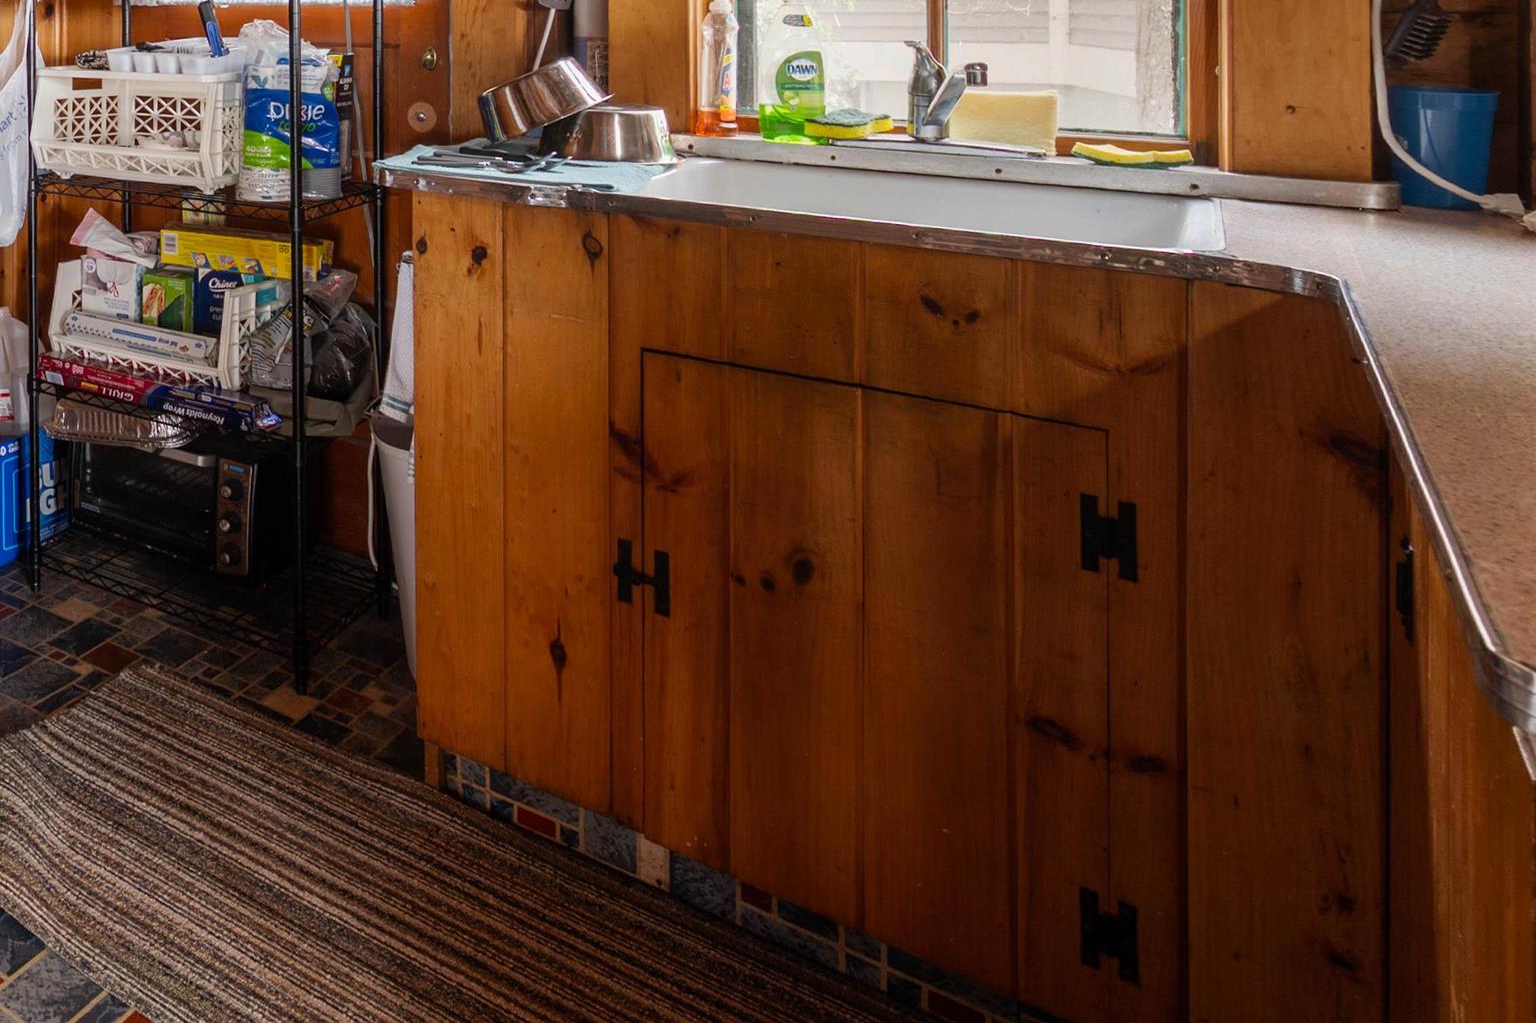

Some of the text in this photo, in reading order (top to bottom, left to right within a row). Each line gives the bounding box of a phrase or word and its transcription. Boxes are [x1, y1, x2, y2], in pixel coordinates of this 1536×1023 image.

[787, 64, 818, 75] DAWN
[163, 402, 185, 416] Wrap
[185, 408, 225, 425] Reynolds
